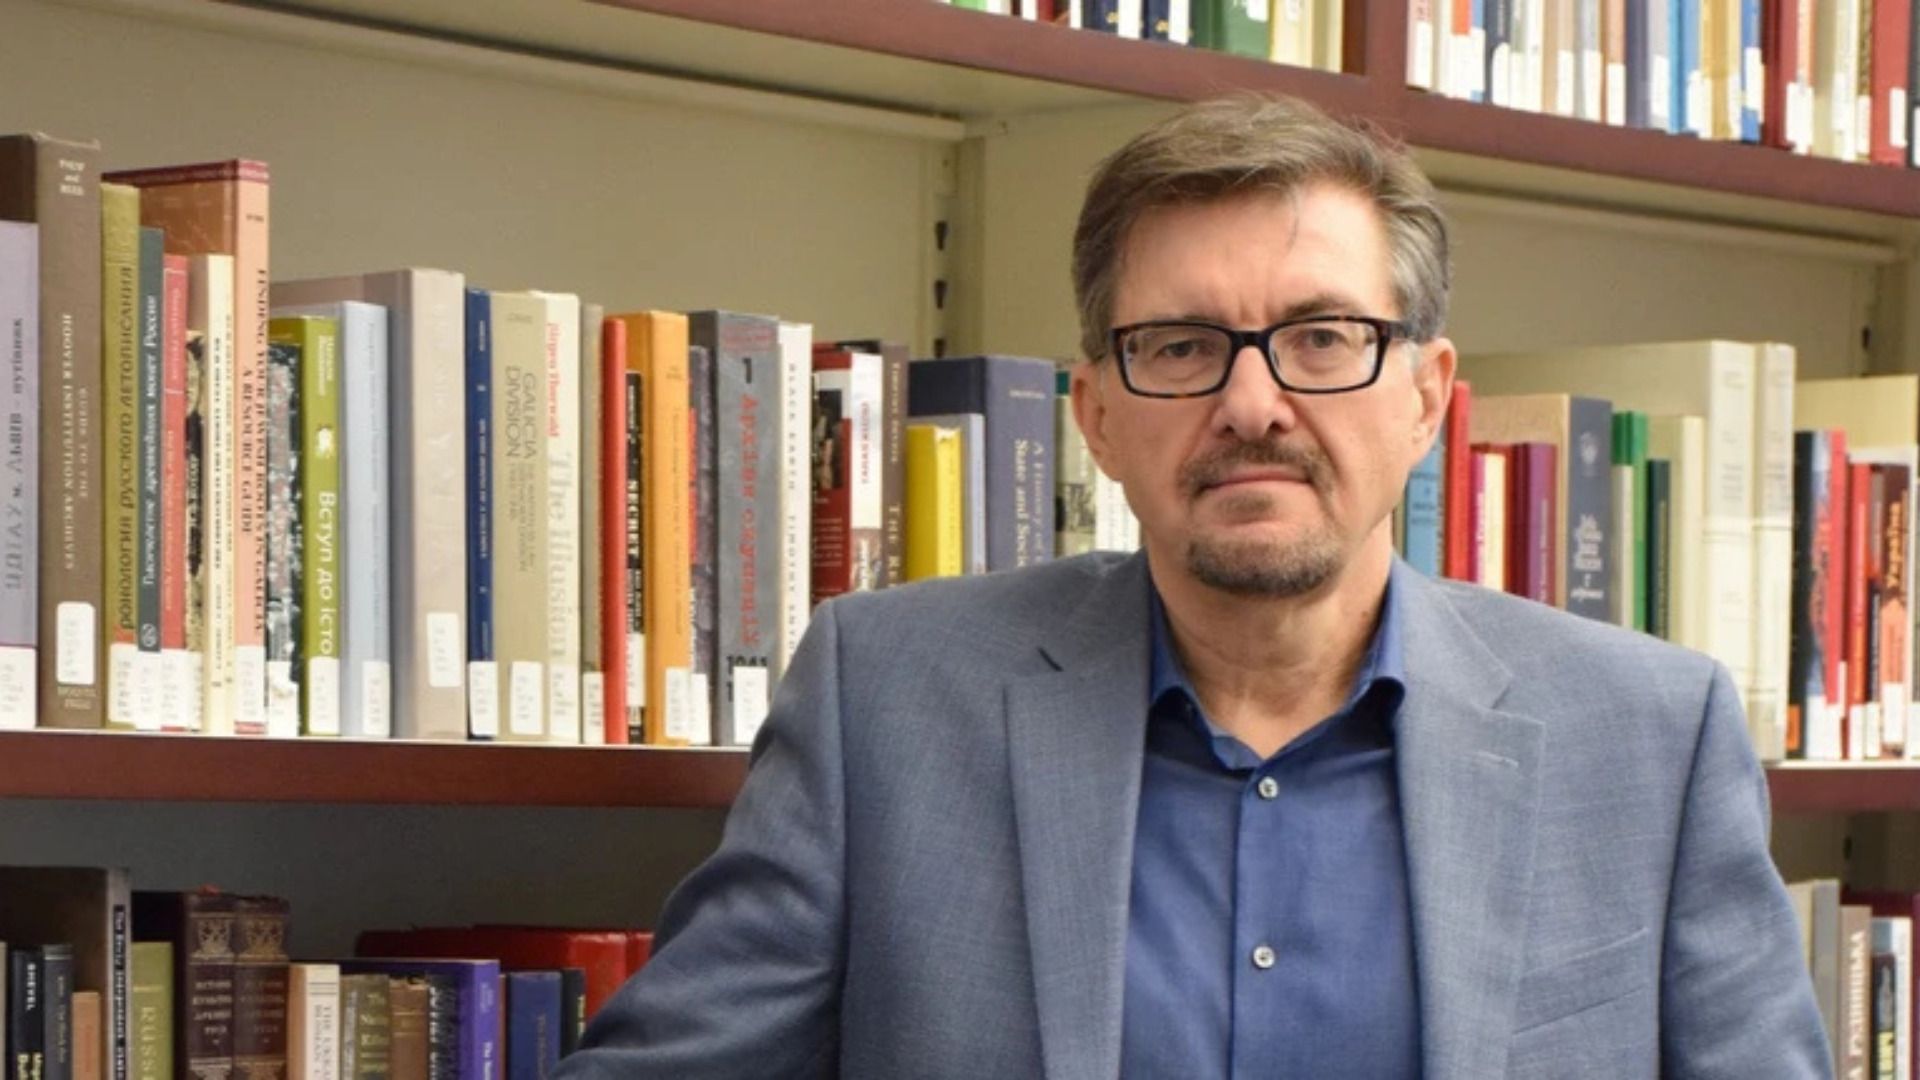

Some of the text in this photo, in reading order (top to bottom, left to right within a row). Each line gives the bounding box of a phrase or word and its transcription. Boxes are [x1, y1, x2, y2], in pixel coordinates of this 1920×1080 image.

[117, 265, 134, 408] летописания
[143, 294, 157, 347] России
[257, 269, 269, 345] FINDING
[257, 351, 269, 397] YOUR
[787, 362, 796, 421] BLACK
[62, 314, 75, 570] HOOVER INSTITUTION ARCHIVES
[242, 383, 253, 473] RESOURCE
[256, 402, 269, 467] JEWISH
[505, 365, 522, 457] DIVISION
[523, 372, 538, 460] GALICIA
[740, 393, 761, 498] Архіви
[117, 412, 135, 510] русского
[787, 431, 796, 491] EARTH
[1014, 439, 1029, 481] State
[241, 480, 253, 534] GUIDE
[256, 472, 268, 532] ROOTS
[317, 490, 337, 562] Вступ
[628, 480, 640, 558] SECRET
[1014, 486, 1029, 519] and
[316, 567, 334, 600] до
[548, 452, 574, 657] The Illusion
[787, 515, 796, 593] TIMOTHY
[25, 963, 37, 1012] SHEVEL
